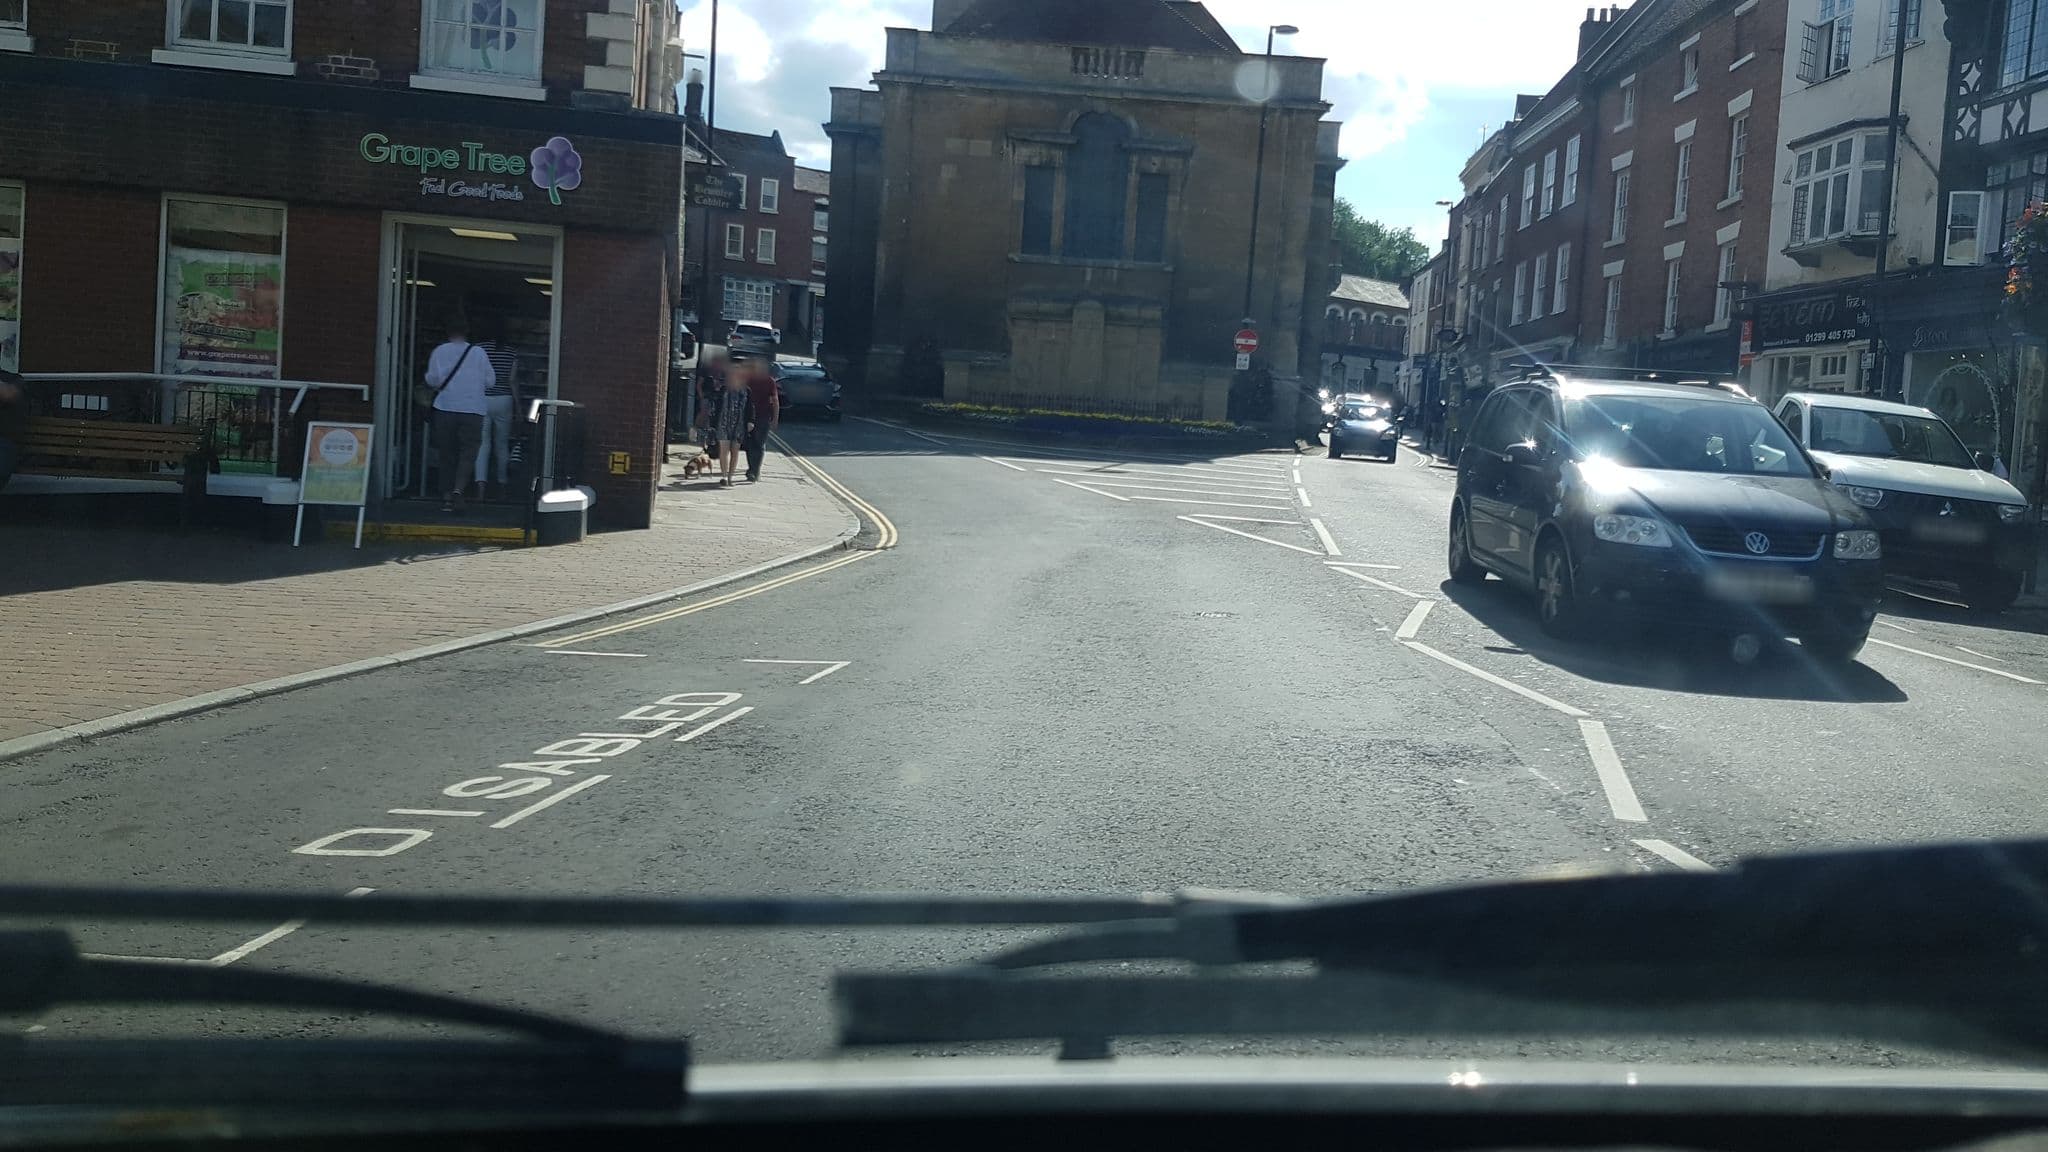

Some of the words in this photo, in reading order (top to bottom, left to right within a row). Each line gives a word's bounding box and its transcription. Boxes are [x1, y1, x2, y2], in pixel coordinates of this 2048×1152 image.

[360, 133, 460, 174] Grape
[462, 141, 526, 176] Tree
[420, 177, 446, 195] Feel
[447, 181, 488, 197] Good
[488, 184, 524, 201] Foods
[1805, 332, 1826, 343] 01299
[1828, 330, 1841, 340] 405
[1842, 329, 1856, 339] 750
[291, 691, 744, 857] DISABLED
